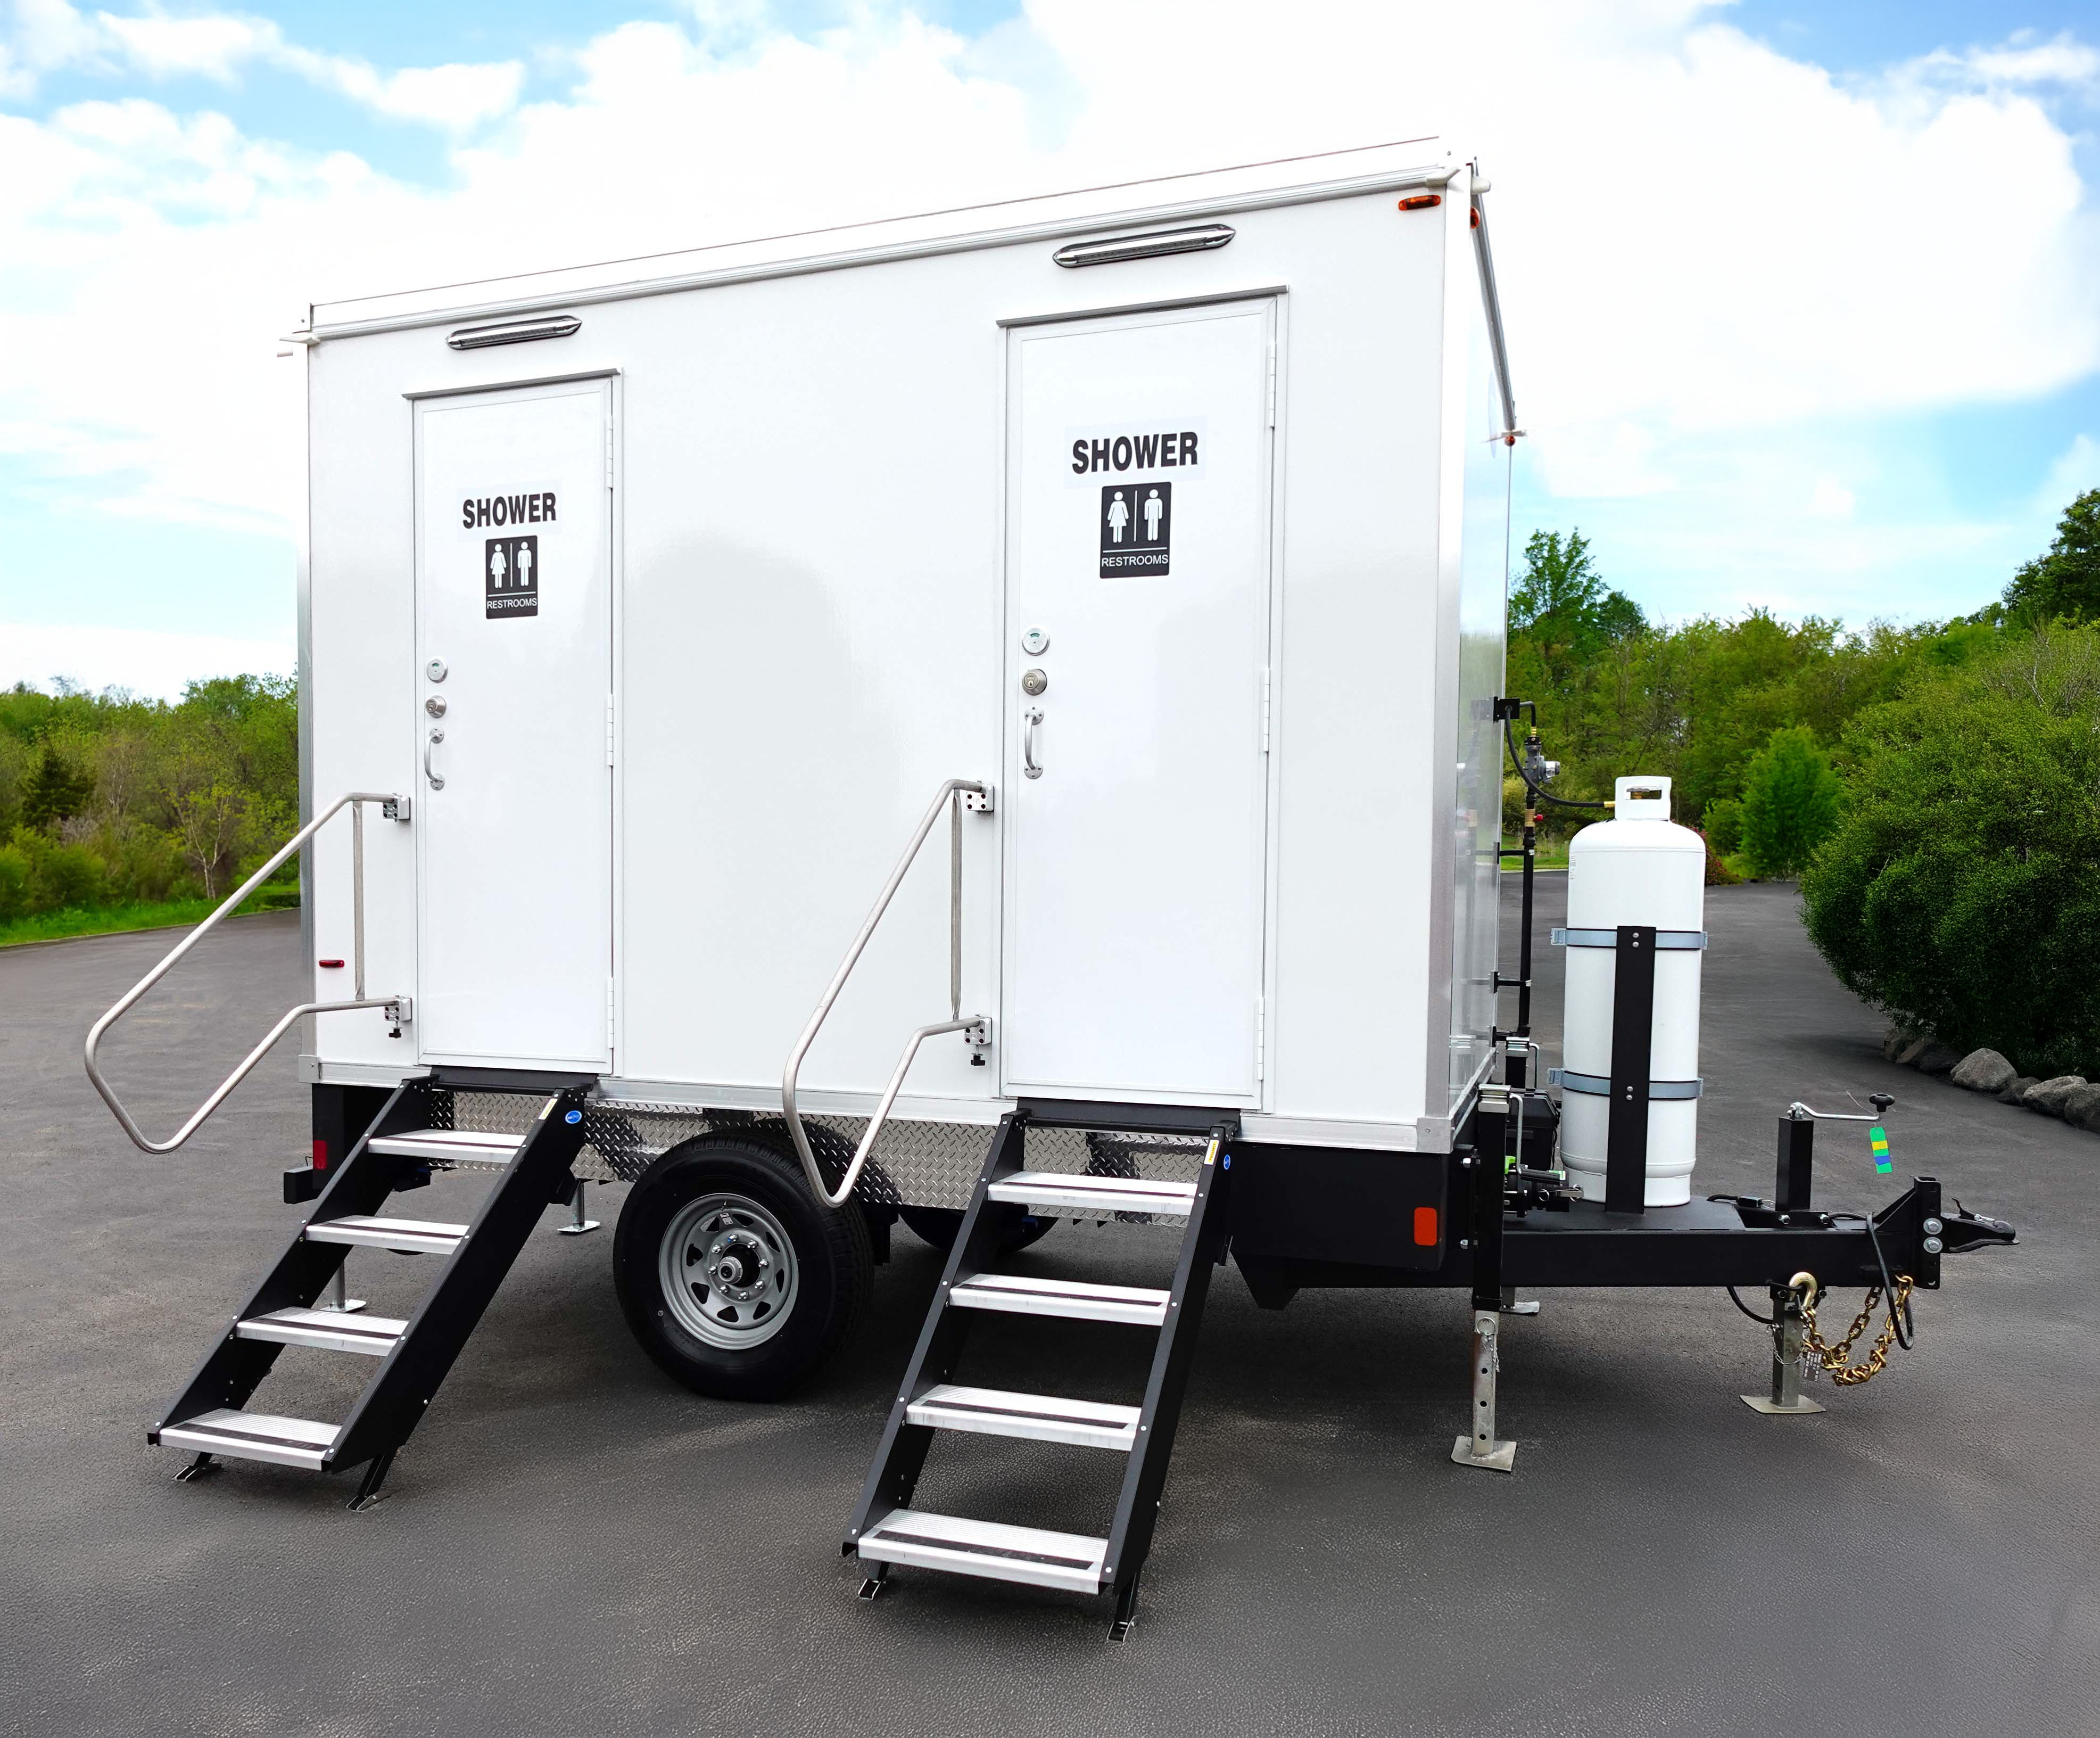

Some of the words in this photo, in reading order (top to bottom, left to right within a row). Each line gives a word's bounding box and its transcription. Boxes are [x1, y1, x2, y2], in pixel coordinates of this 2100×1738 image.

[1072, 431, 1198, 474] SHOWER
[462, 492, 556, 529] SHOWER
[1102, 555, 1169, 567] RESTROOMS
[486, 598, 538, 609] RESTROOMS
